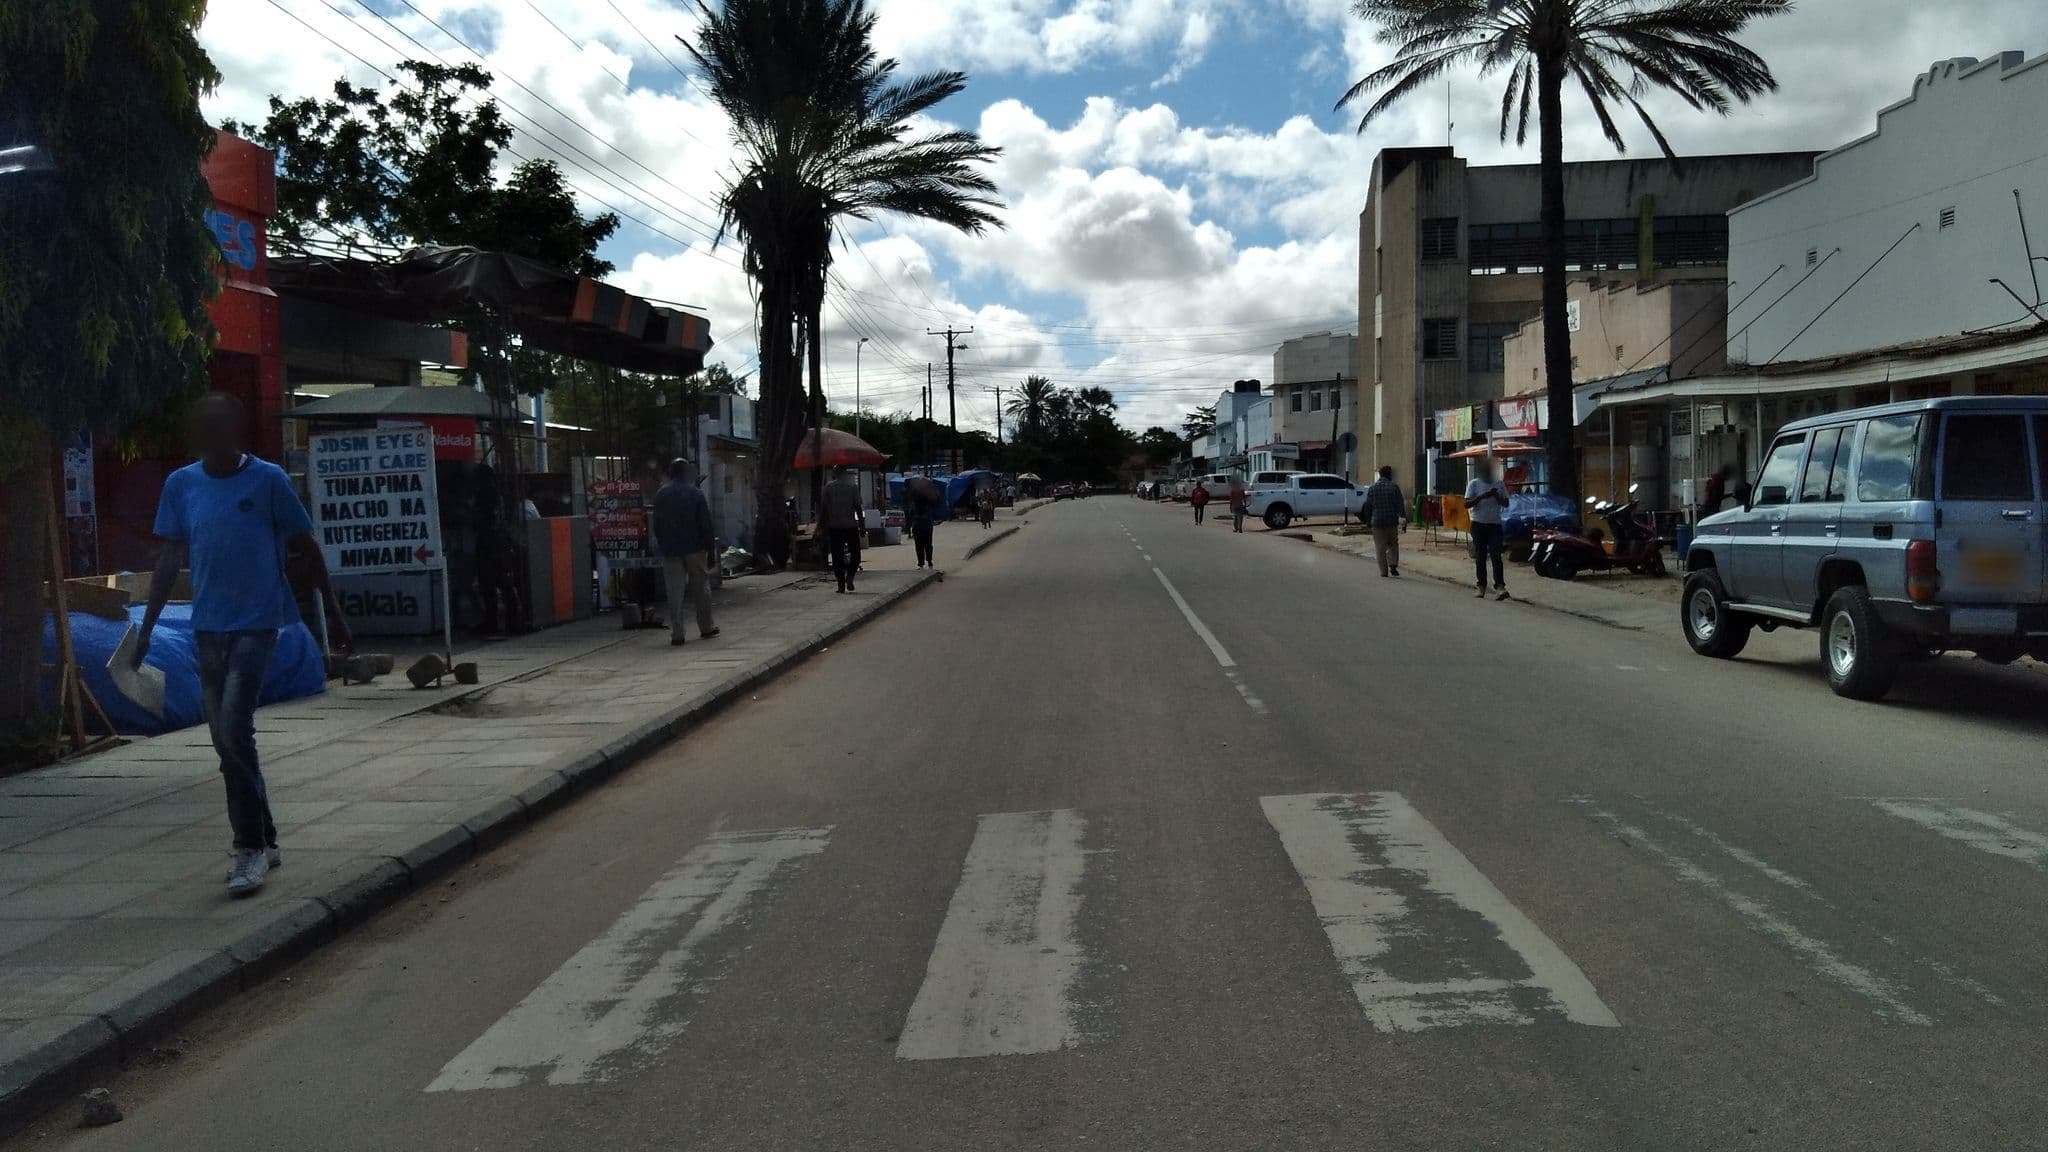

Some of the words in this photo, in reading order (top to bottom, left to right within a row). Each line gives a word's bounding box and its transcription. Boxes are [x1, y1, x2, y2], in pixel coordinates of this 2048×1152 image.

[317, 437, 369, 453] JDSM
[375, 433, 413, 450] EYE
[317, 456, 372, 473] SIGHT
[379, 453, 427, 470] CARE
[324, 474, 423, 497] TUNAPIMA
[321, 500, 389, 521] MACHO
[400, 498, 427, 517] NA
[324, 522, 430, 545] KUTENGENEZA
[341, 546, 414, 568] MIWANI
